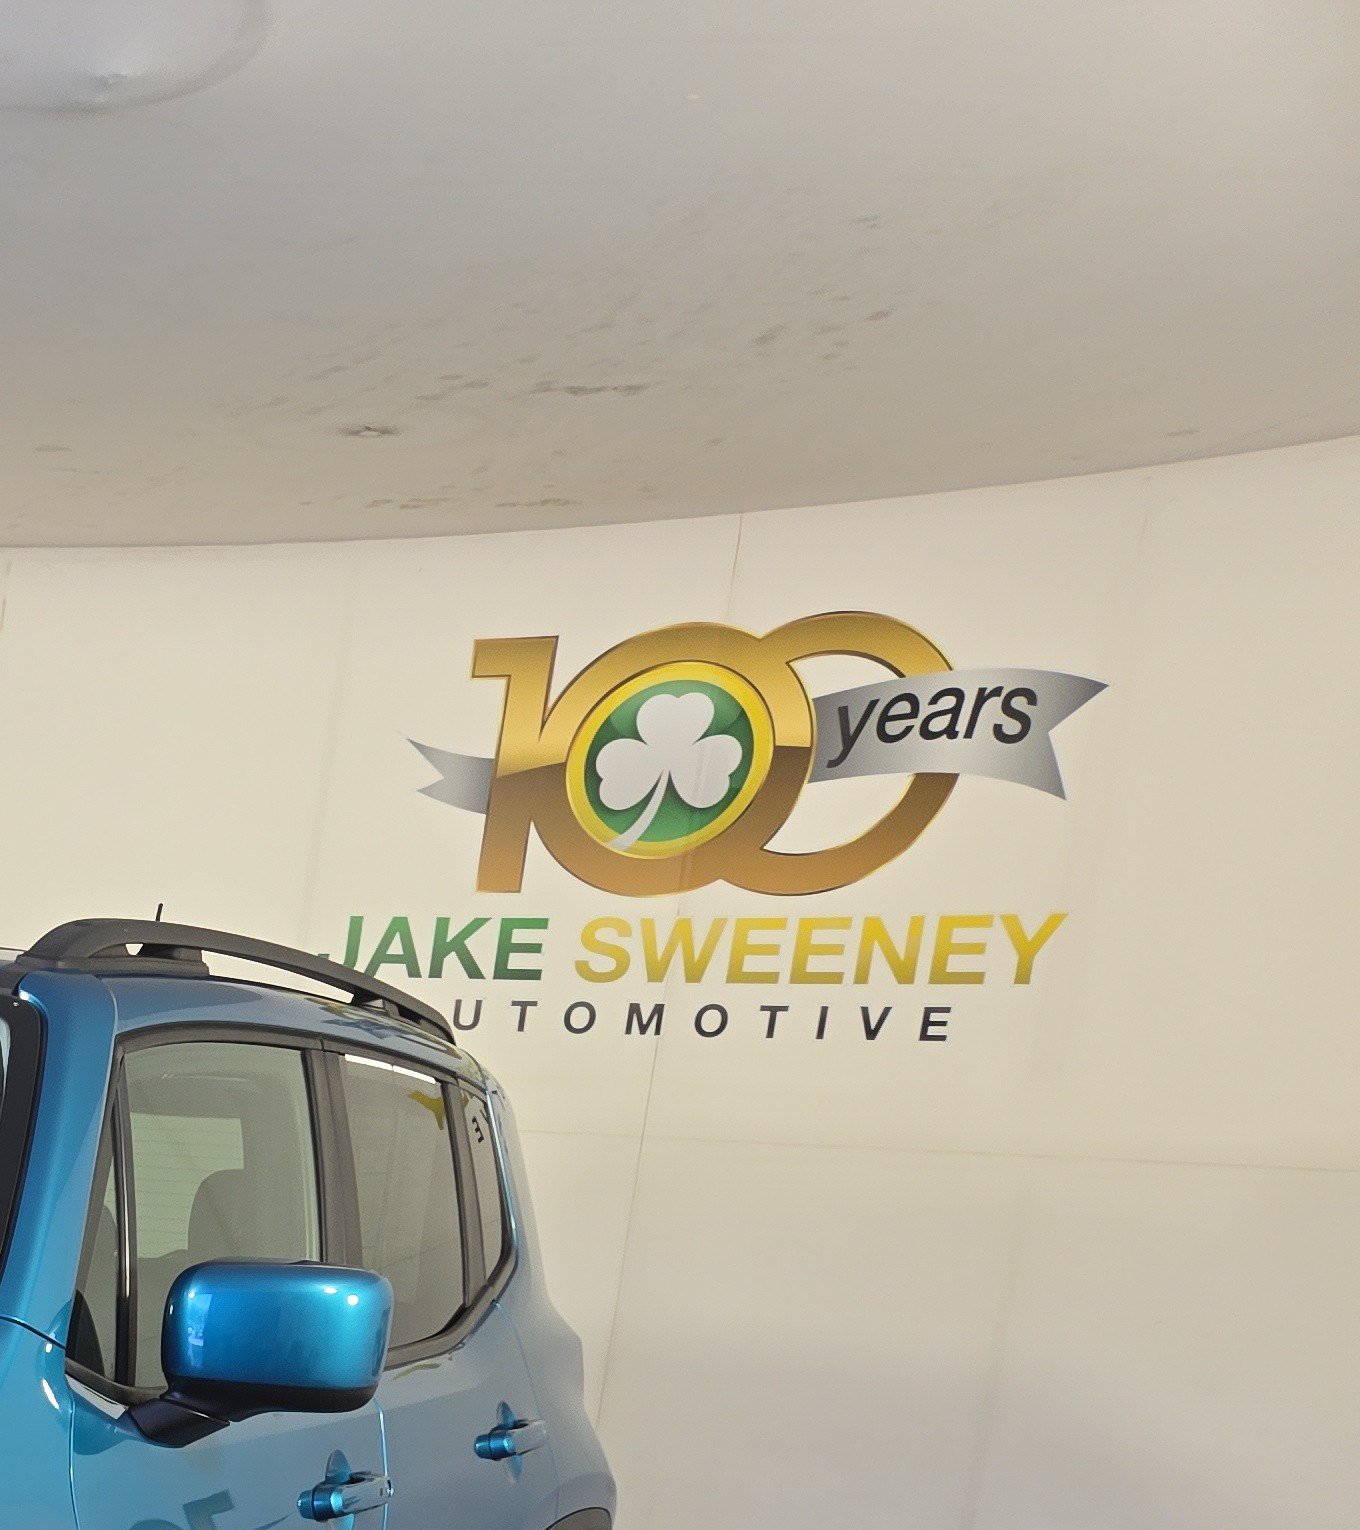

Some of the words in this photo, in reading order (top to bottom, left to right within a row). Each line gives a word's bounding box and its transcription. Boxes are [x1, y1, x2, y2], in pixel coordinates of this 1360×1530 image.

[470, 611, 961, 898] 100
[826, 685, 1038, 770] years
[574, 912, 1068, 986] SWEENEY
[452, 998, 953, 1044] UTOMOTIVE
